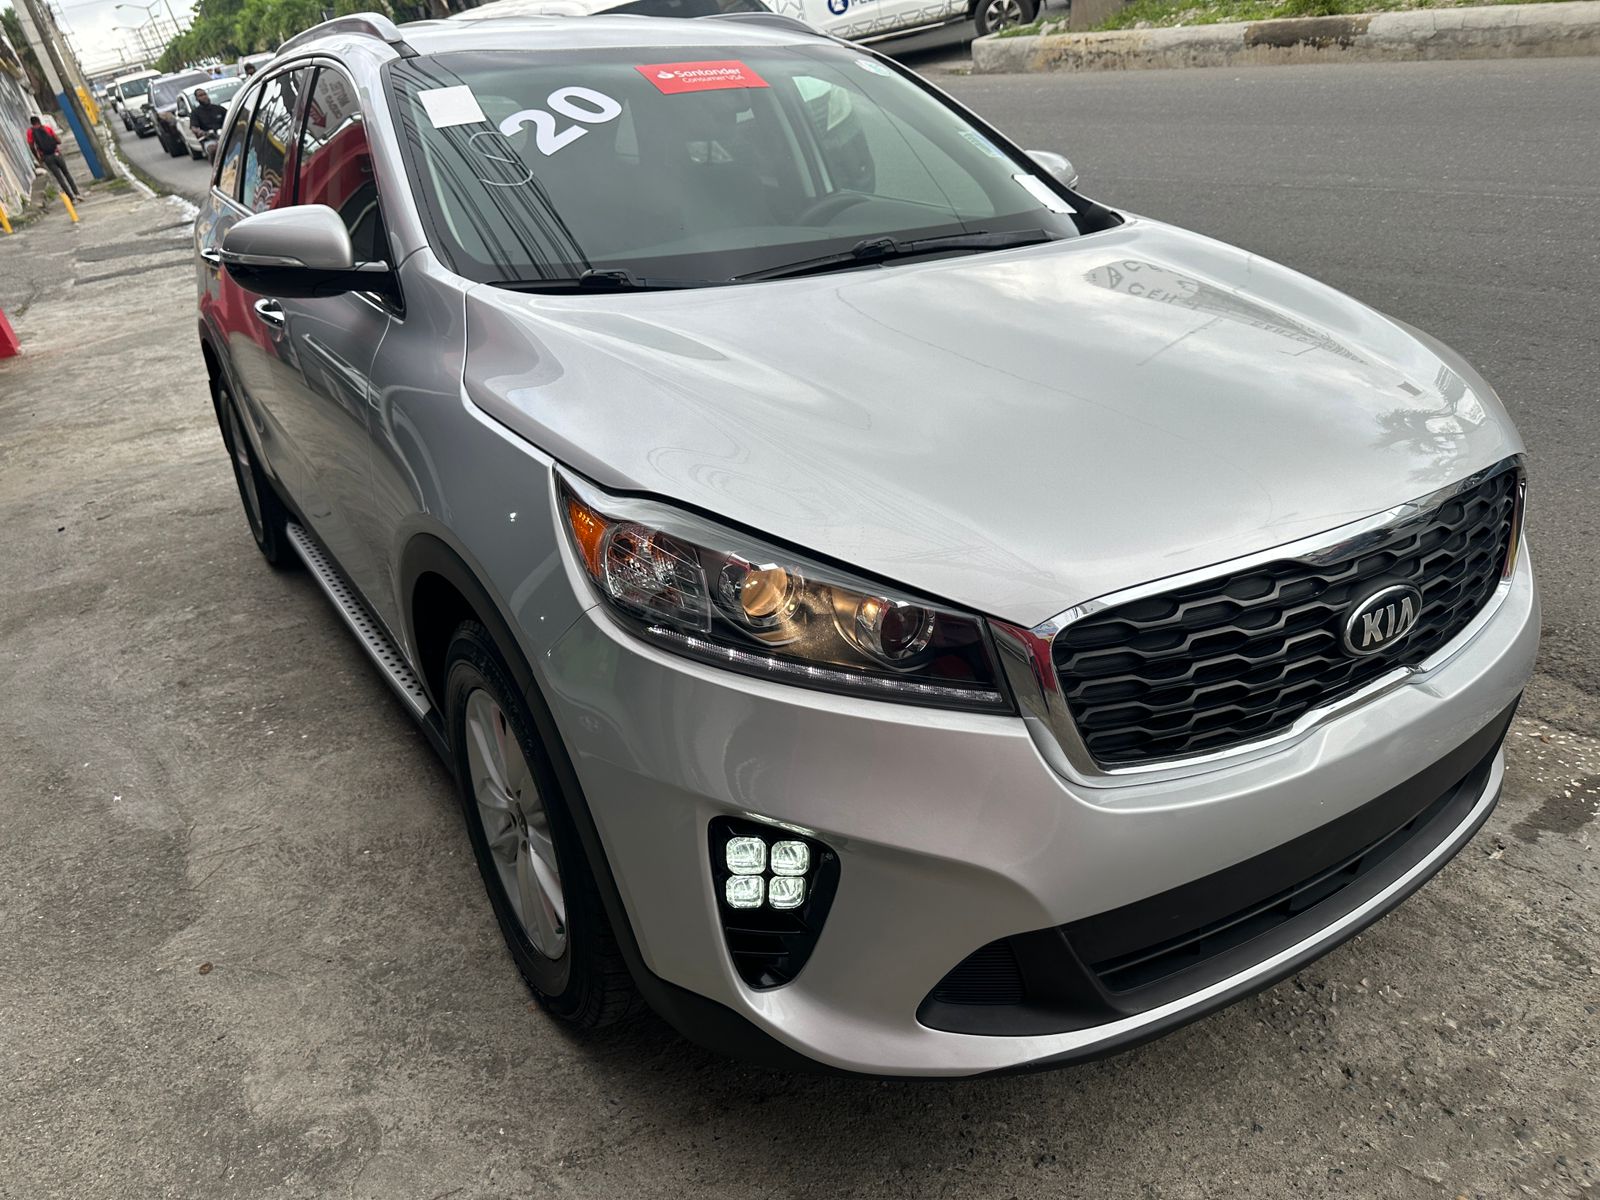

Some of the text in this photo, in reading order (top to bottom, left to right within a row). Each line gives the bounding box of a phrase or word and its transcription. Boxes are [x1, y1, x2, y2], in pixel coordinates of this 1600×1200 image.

[673, 68, 741, 78] Santander
[499, 86, 623, 157] 20
[1361, 596, 1414, 647] KIA
